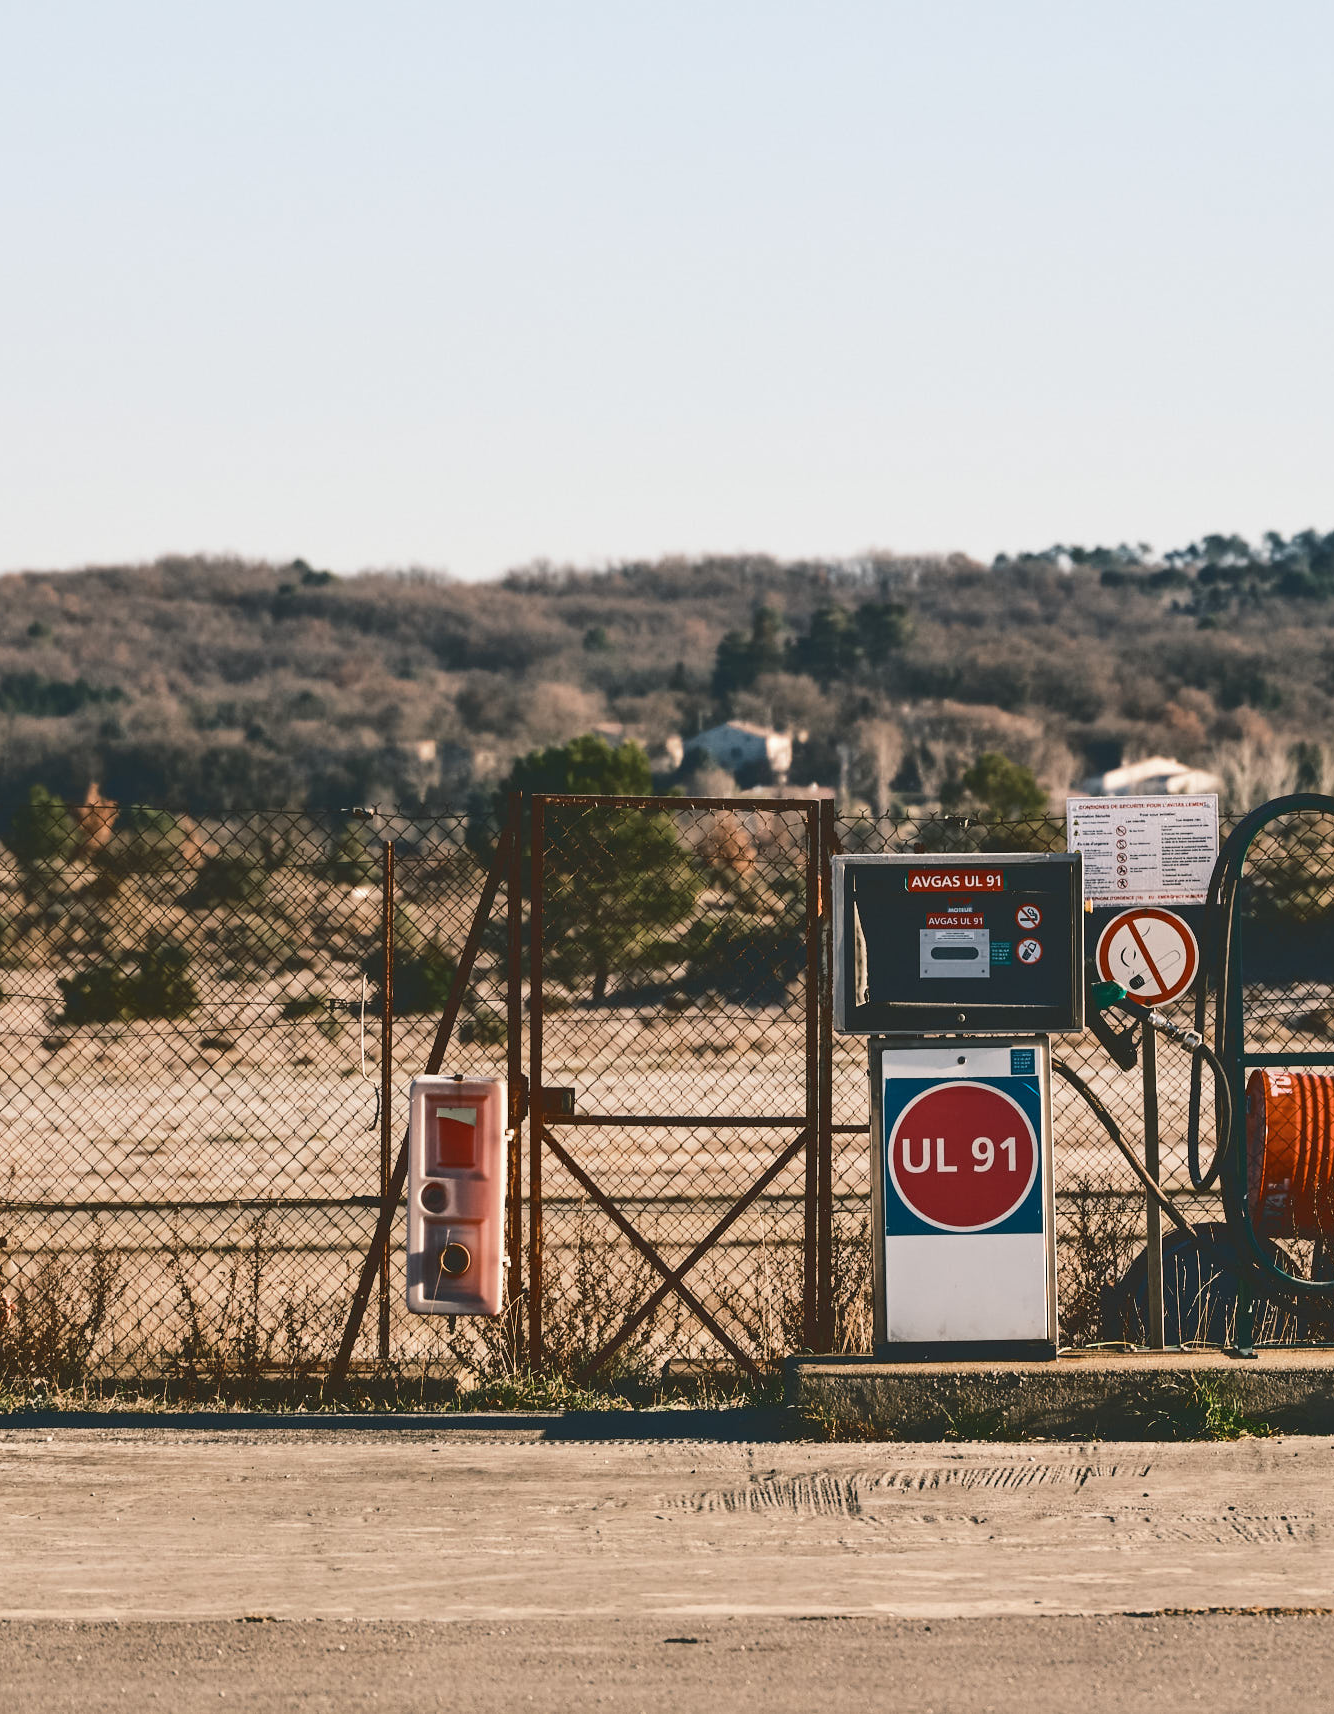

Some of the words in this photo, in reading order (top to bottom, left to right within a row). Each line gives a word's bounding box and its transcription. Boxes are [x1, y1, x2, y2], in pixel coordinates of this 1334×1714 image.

[911, 875, 961, 888] AVGAS
[964, 875, 984, 888] UL
[986, 874, 1002, 888] 91
[928, 917, 958, 925] AVGAS
[960, 917, 972, 925] UL
[973, 917, 983, 925] 91
[902, 1137, 958, 1174] UL
[971, 1136, 1017, 1173] 91
